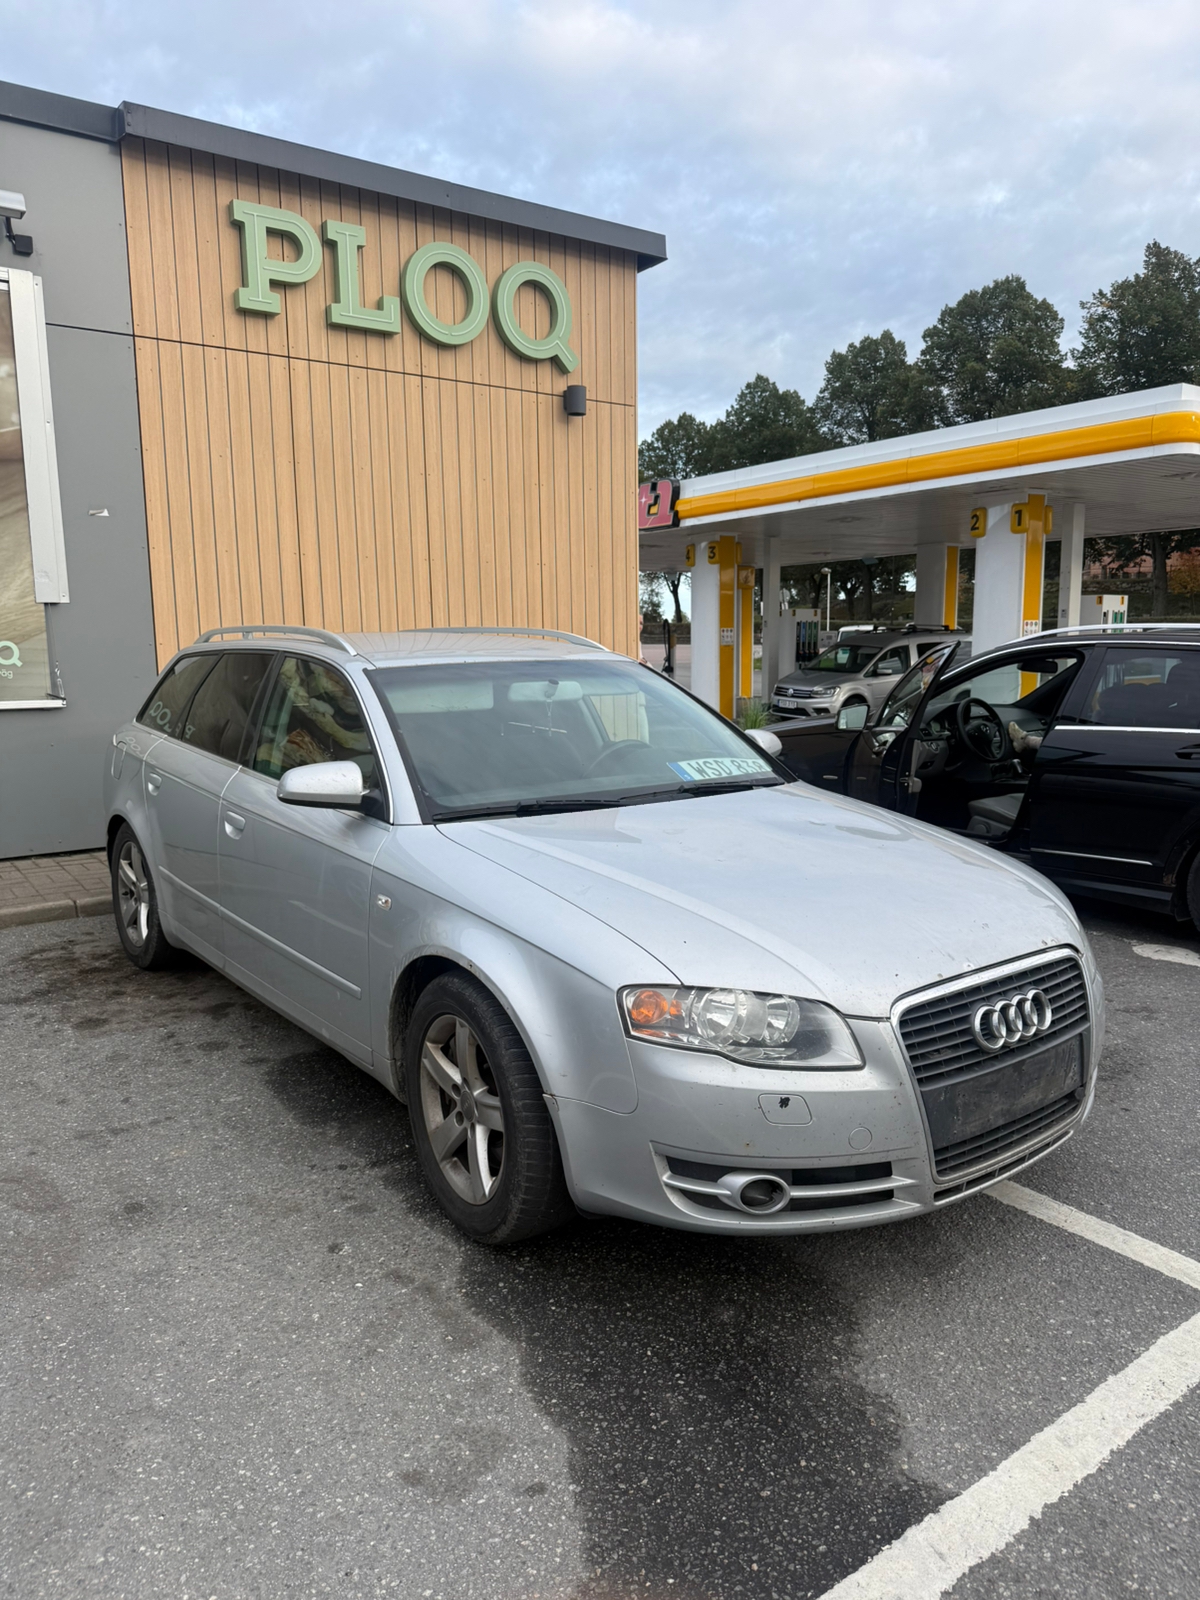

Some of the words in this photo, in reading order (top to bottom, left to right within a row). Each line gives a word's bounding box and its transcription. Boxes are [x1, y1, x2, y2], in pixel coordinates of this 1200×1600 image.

[229, 199, 580, 374] PLOQ
[970, 513, 980, 532] 2
[1014, 509, 1022, 527] 1
[685, 548, 691, 562] 4
[708, 545, 717, 559] 3
[0, 668, 13, 680] ög
[687, 760, 733, 779] WSD
